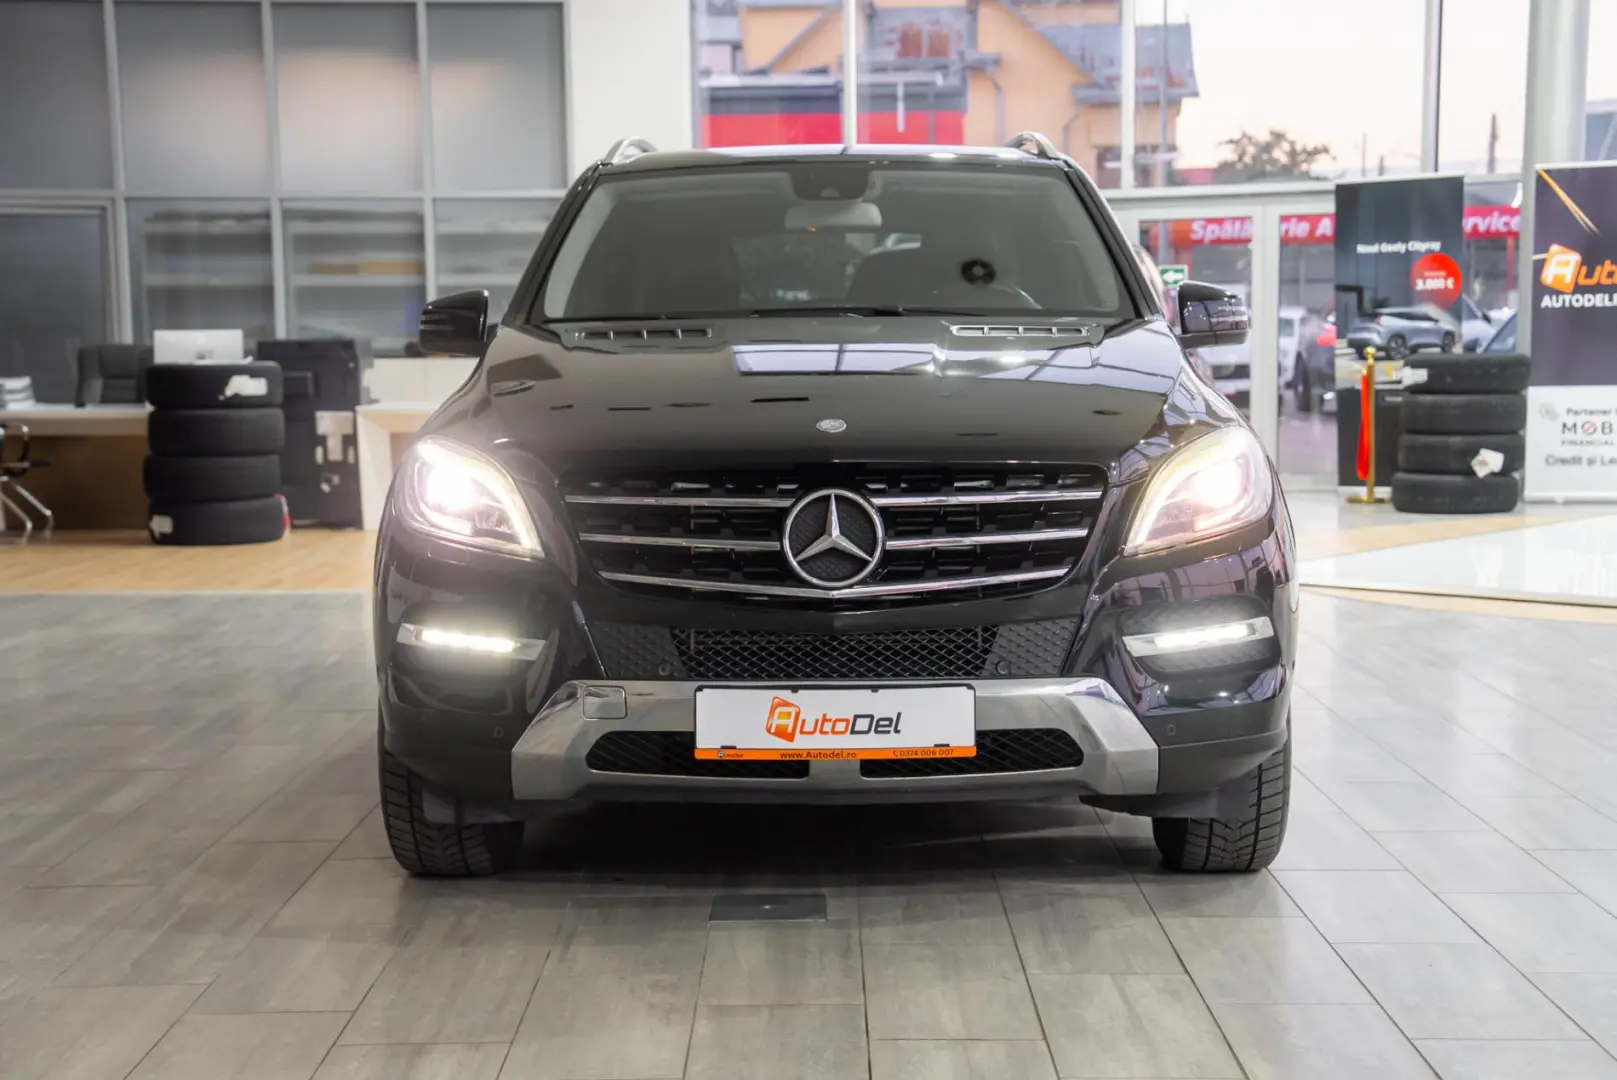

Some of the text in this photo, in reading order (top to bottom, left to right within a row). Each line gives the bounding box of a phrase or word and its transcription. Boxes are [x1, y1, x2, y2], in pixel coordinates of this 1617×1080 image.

[1463, 211, 1520, 233] rvice
[1542, 247, 1617, 290] Aut
[1544, 454, 1582, 466] Credit
[767, 701, 902, 739] AutoDel
[780, 751, 857, 759] www.Autodel.ro
